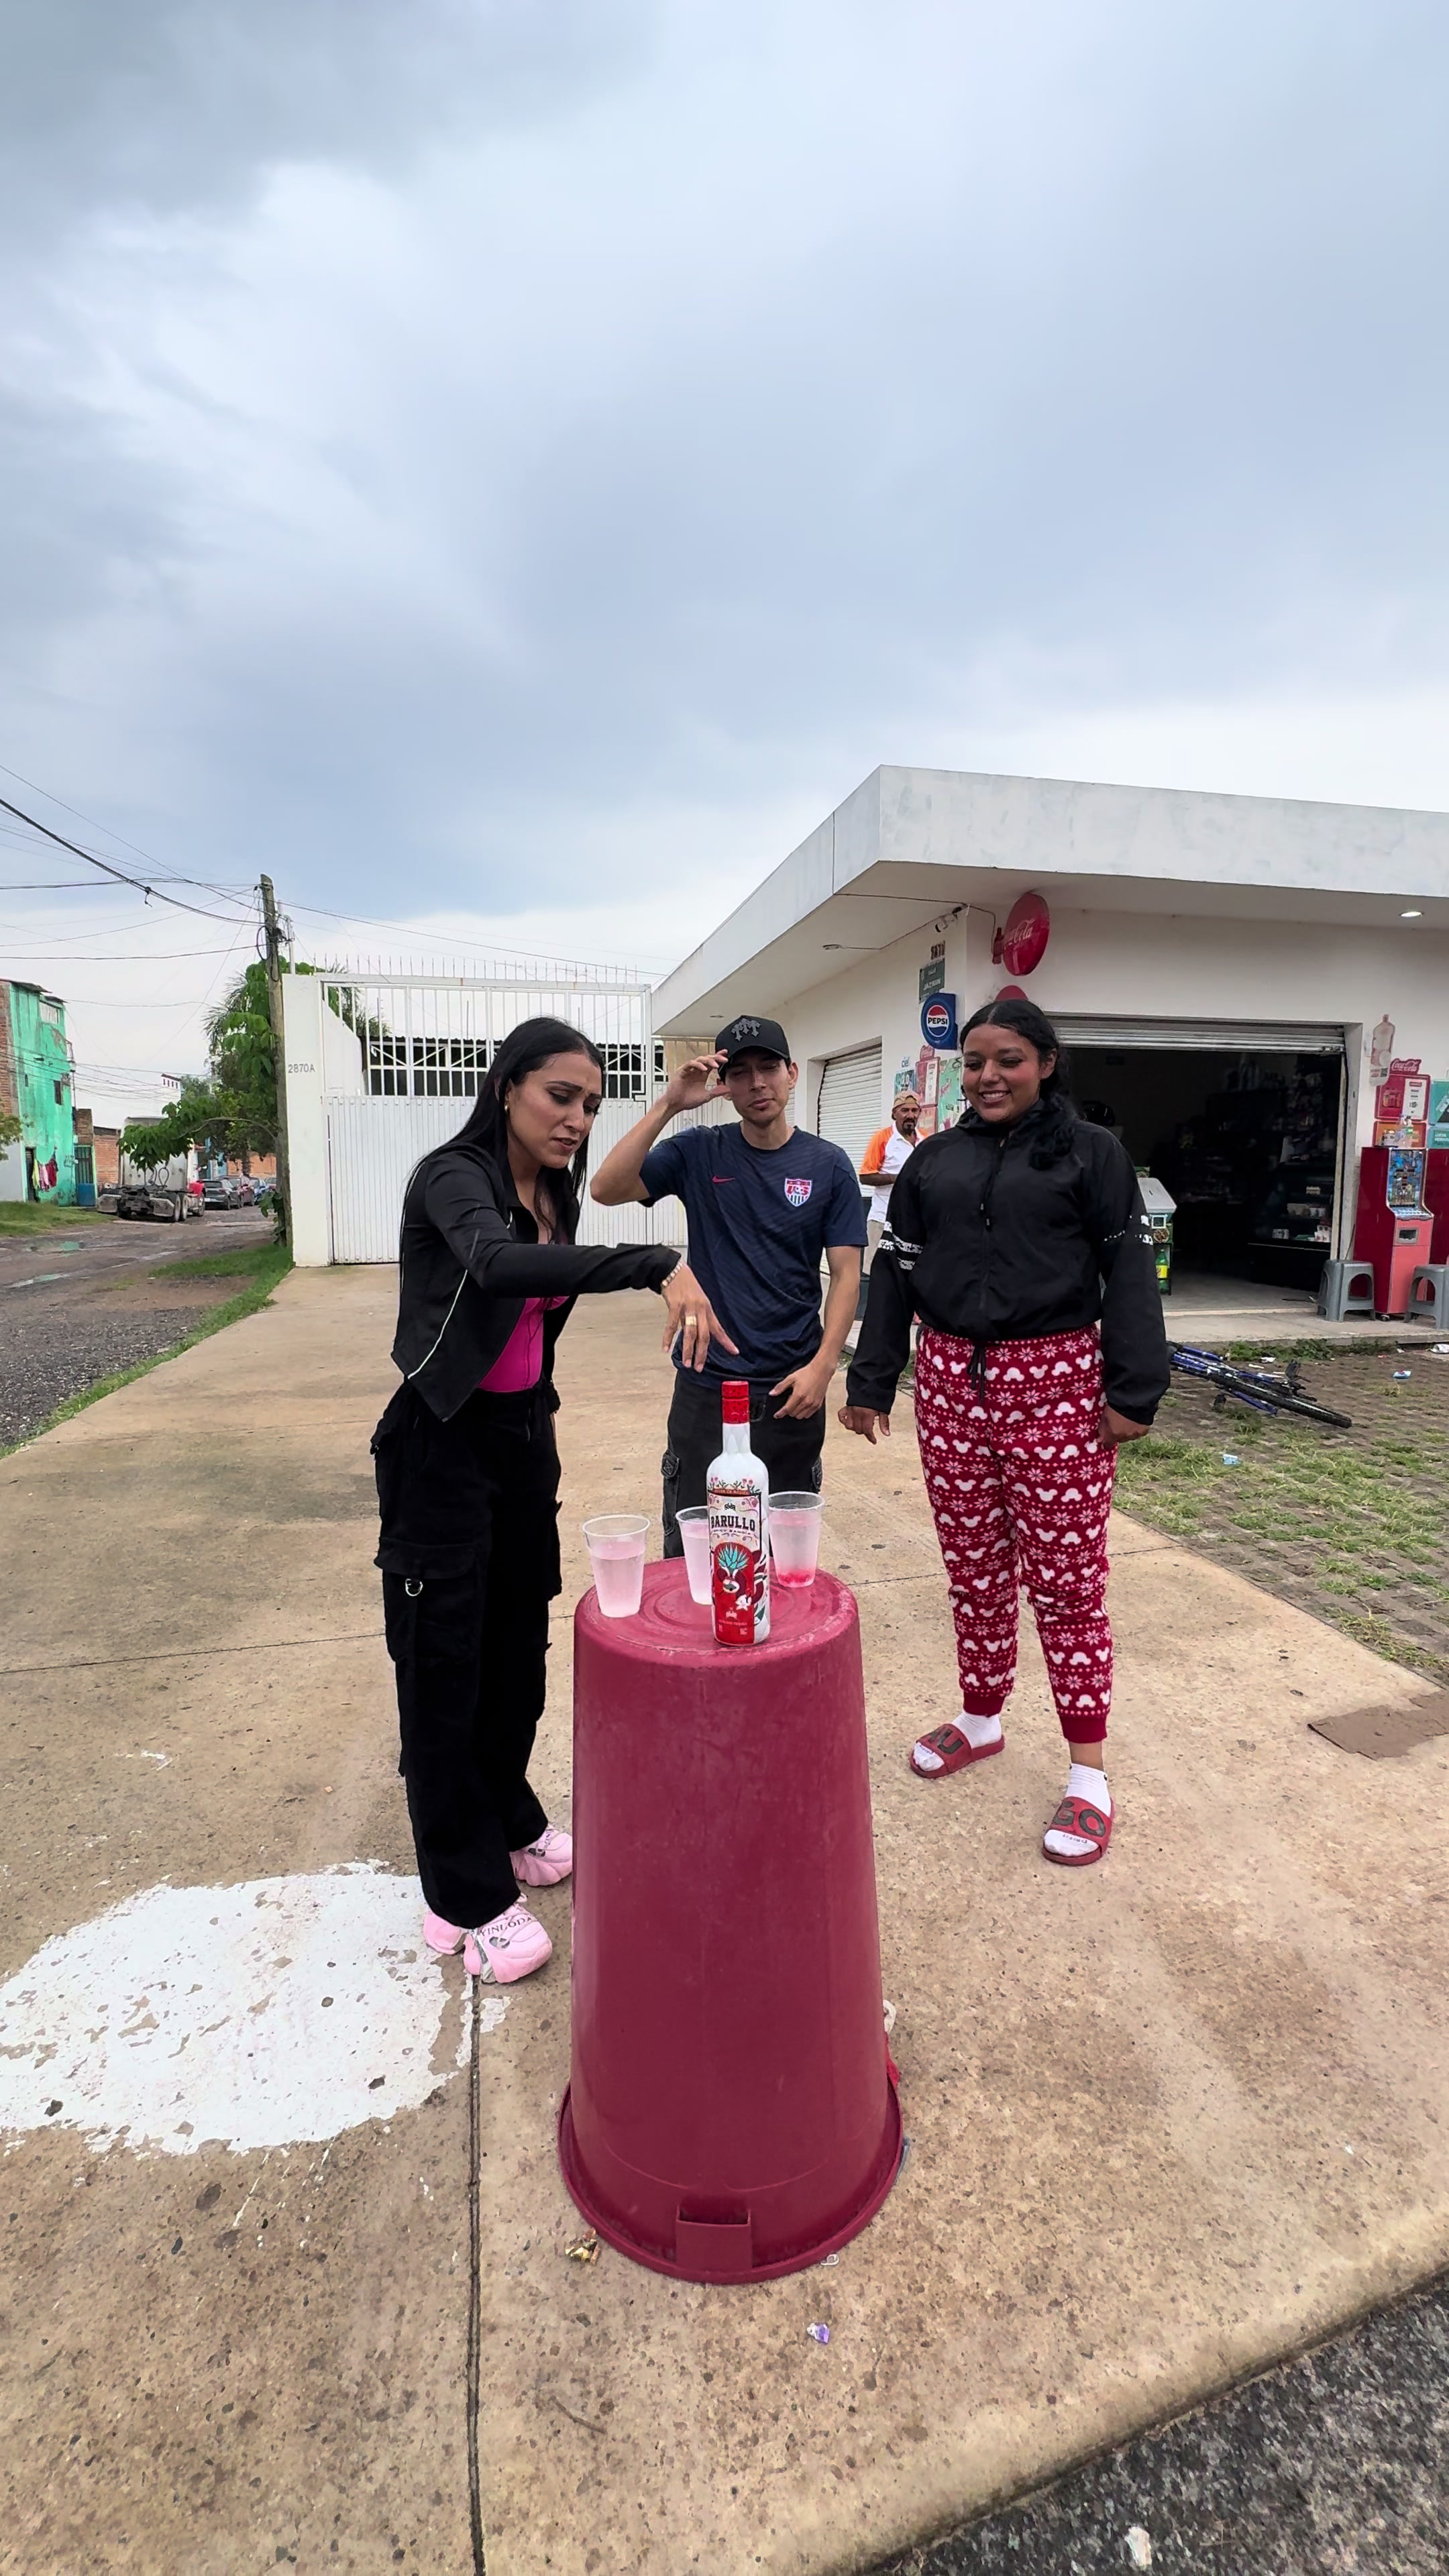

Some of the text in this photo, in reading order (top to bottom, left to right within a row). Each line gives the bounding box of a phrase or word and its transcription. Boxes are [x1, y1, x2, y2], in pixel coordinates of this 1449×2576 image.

[928, 1017, 948, 1025] PEPSI
[288, 1063, 316, 1073] 2870A
[710, 1515, 755, 1532] BARULLO
